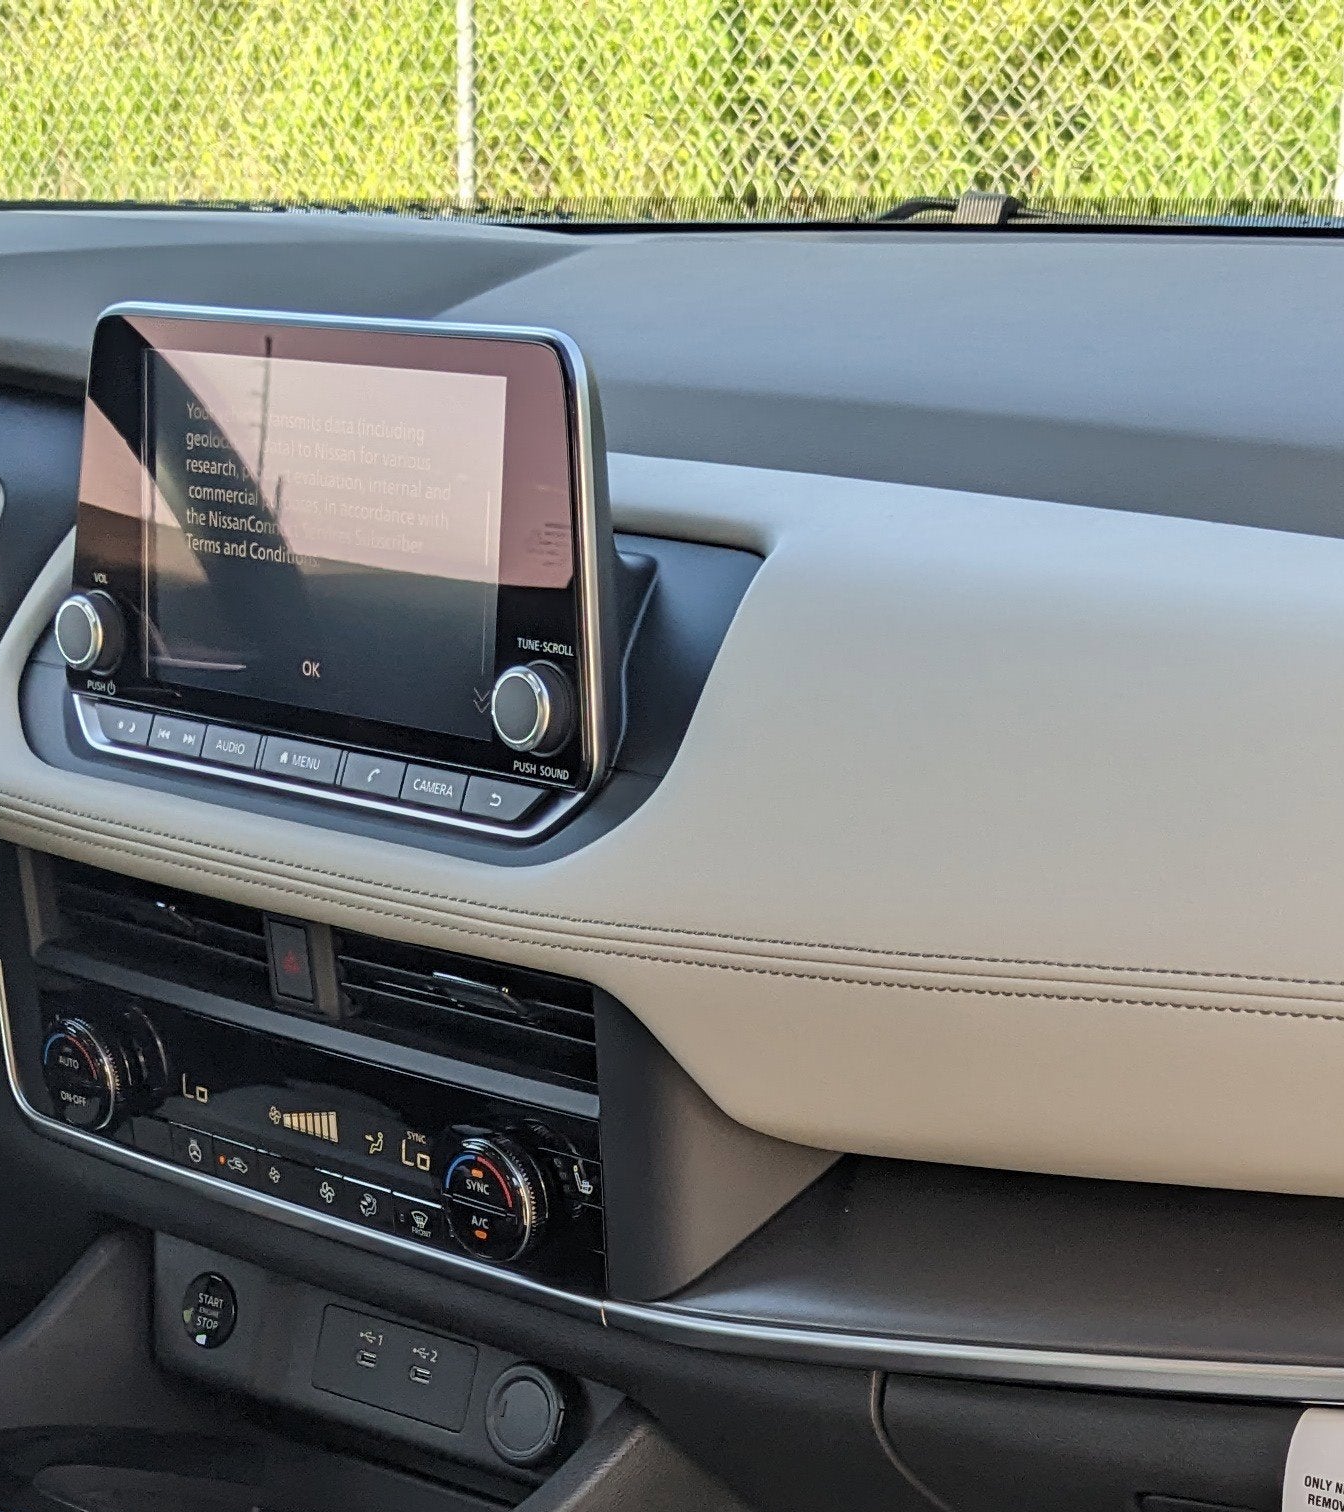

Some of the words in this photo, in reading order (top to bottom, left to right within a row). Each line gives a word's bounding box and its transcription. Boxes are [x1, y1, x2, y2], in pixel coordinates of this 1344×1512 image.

[188, 484, 258, 506] commercial
[186, 507, 207, 525] the
[186, 532, 221, 555] Terms
[223, 540, 247, 558] and
[94, 572, 108, 584] VOL
[302, 661, 321, 678] OK
[87, 679, 106, 691] PUSH
[215, 738, 246, 755] AUDIO
[291, 754, 320, 771] MENU
[513, 760, 537, 775] PUSH
[539, 765, 570, 781] SOUND
[412, 778, 454, 797] CAMERA
[59, 1055, 80, 1070] AUTO
[406, 1131, 427, 1145] SYNC
[465, 1179, 490, 1195] SYNC
[471, 1215, 489, 1230] A/C
[198, 1292, 224, 1309] START
[196, 1316, 219, 1331] STOP
[1304, 1475, 1333, 1492] ONLY
